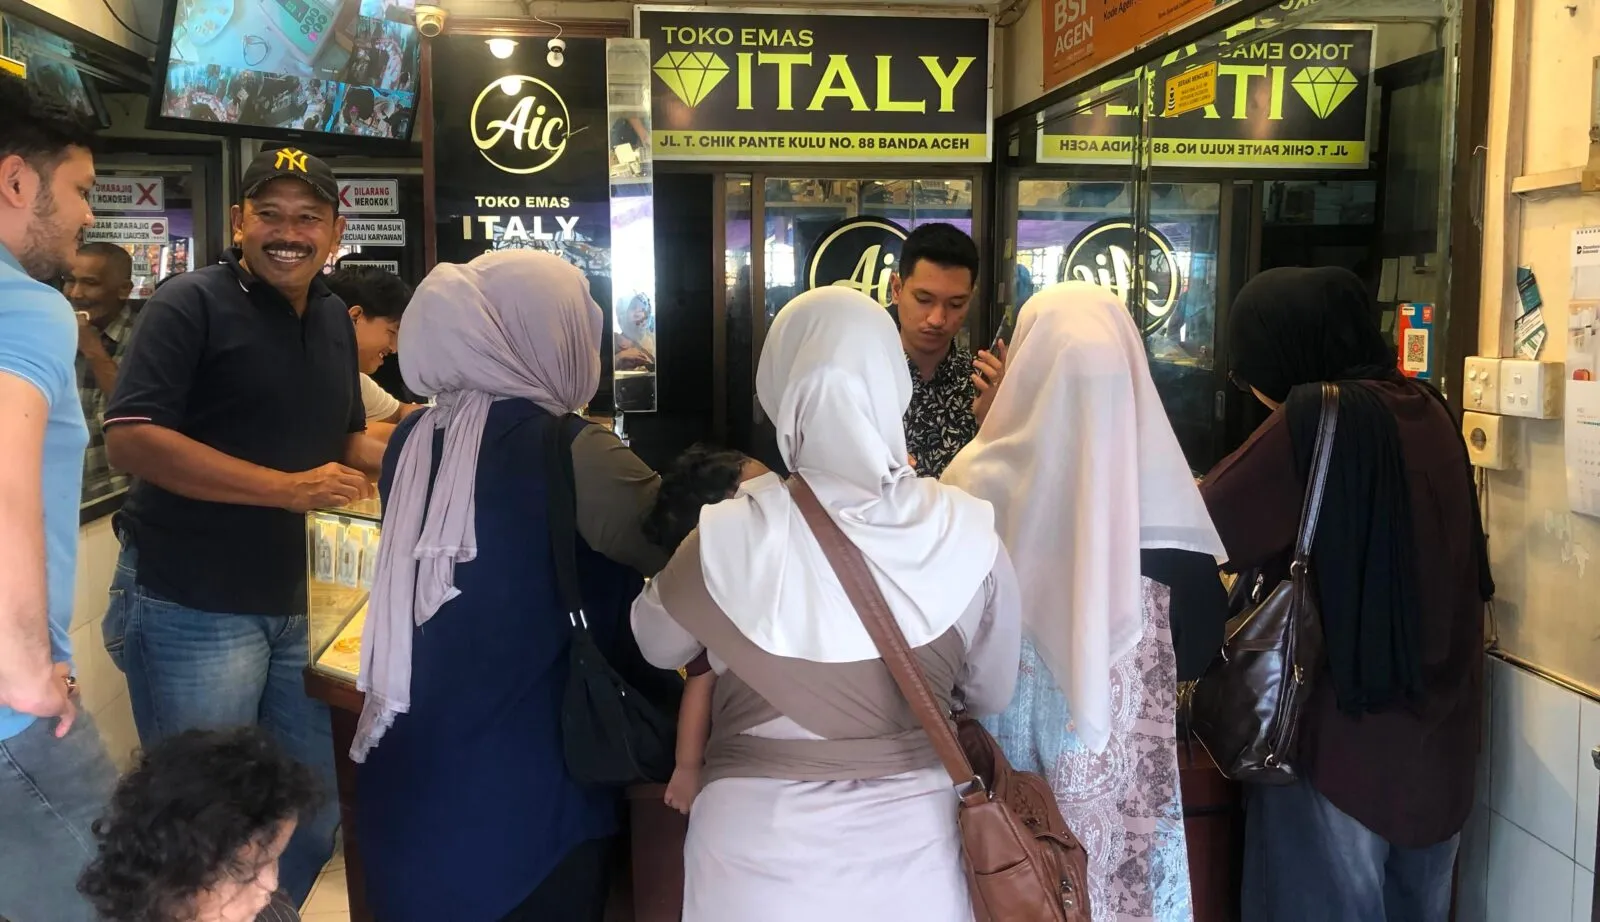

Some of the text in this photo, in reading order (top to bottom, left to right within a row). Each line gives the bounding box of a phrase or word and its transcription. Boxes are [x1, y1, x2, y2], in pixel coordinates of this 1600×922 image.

[1054, 0, 1087, 33] BSI
[661, 26, 814, 47] TOKO EMAS
[1054, 15, 1094, 58] AGEN
[735, 50, 977, 115] ITALY
[478, 95, 567, 152] Aic
[660, 135, 969, 150] JL. T. CHIK PANTE KULU NO. 88 BANDA ACEH
[354, 187, 390, 196] DILARANG
[354, 197, 389, 206] MEROKOK
[474, 195, 570, 208] TOKO EMAS
[344, 223, 376, 231] ILARANG
[462, 215, 580, 241] ITALY
[367, 233, 403, 241] KARYAWAN
